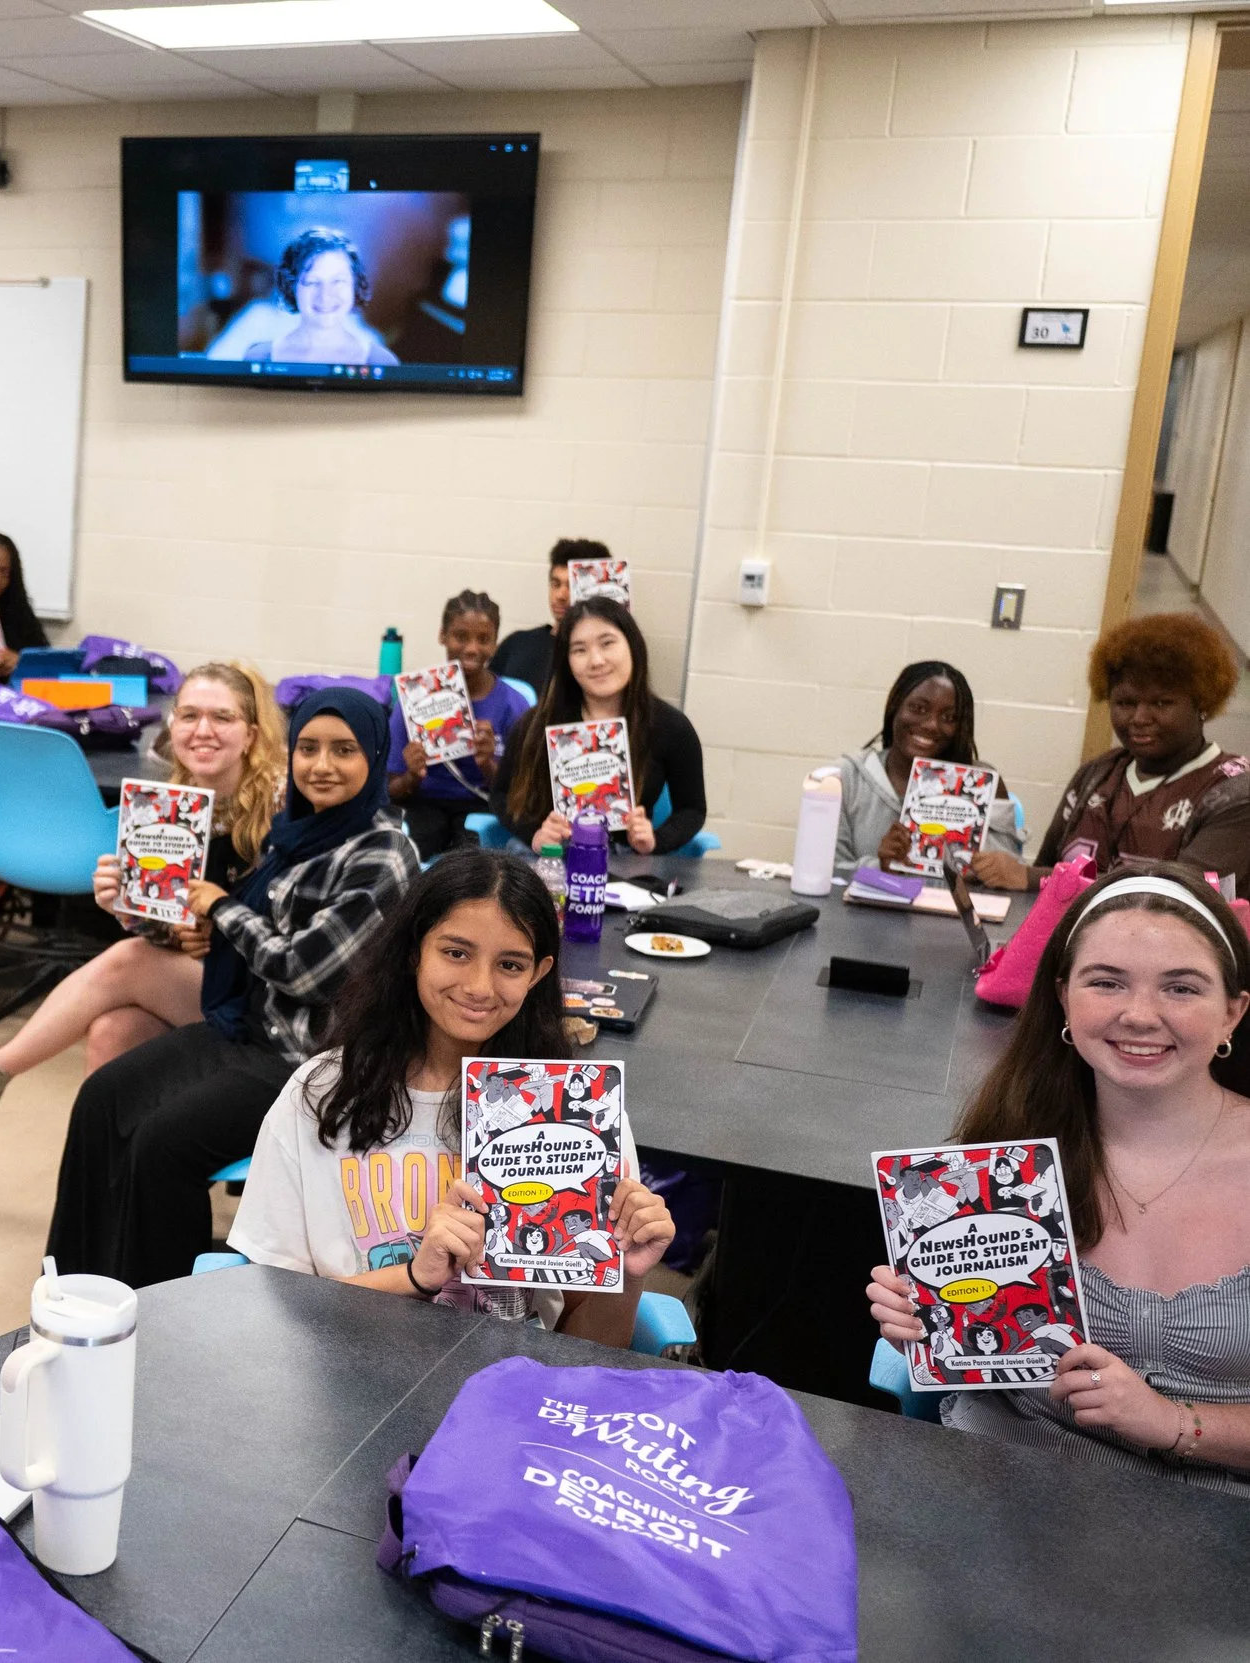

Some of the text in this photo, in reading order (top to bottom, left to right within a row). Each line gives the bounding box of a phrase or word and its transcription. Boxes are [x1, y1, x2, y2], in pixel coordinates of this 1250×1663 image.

[536, 1131, 545, 1140] A
[481, 1151, 604, 1167] GUIDE TO STUDENT
[501, 1164, 584, 1178] JOURNALISM
[508, 1188, 536, 1197] EDITION
[968, 1223, 977, 1233] A
[910, 1239, 1048, 1268] GUIDE TO STUDENT
[935, 1255, 1028, 1277] JOURNALISM
[946, 1287, 979, 1297] EDITION
[543, 1397, 589, 1414] THE
[537, 1406, 697, 1450] DETROIT
[548, 1416, 755, 1516] Writing
[625, 1458, 697, 1505] ROOM
[562, 1469, 698, 1530] COACHING
[523, 1466, 731, 1559] DETROIT
[554, 1497, 694, 1554] FORWARD
